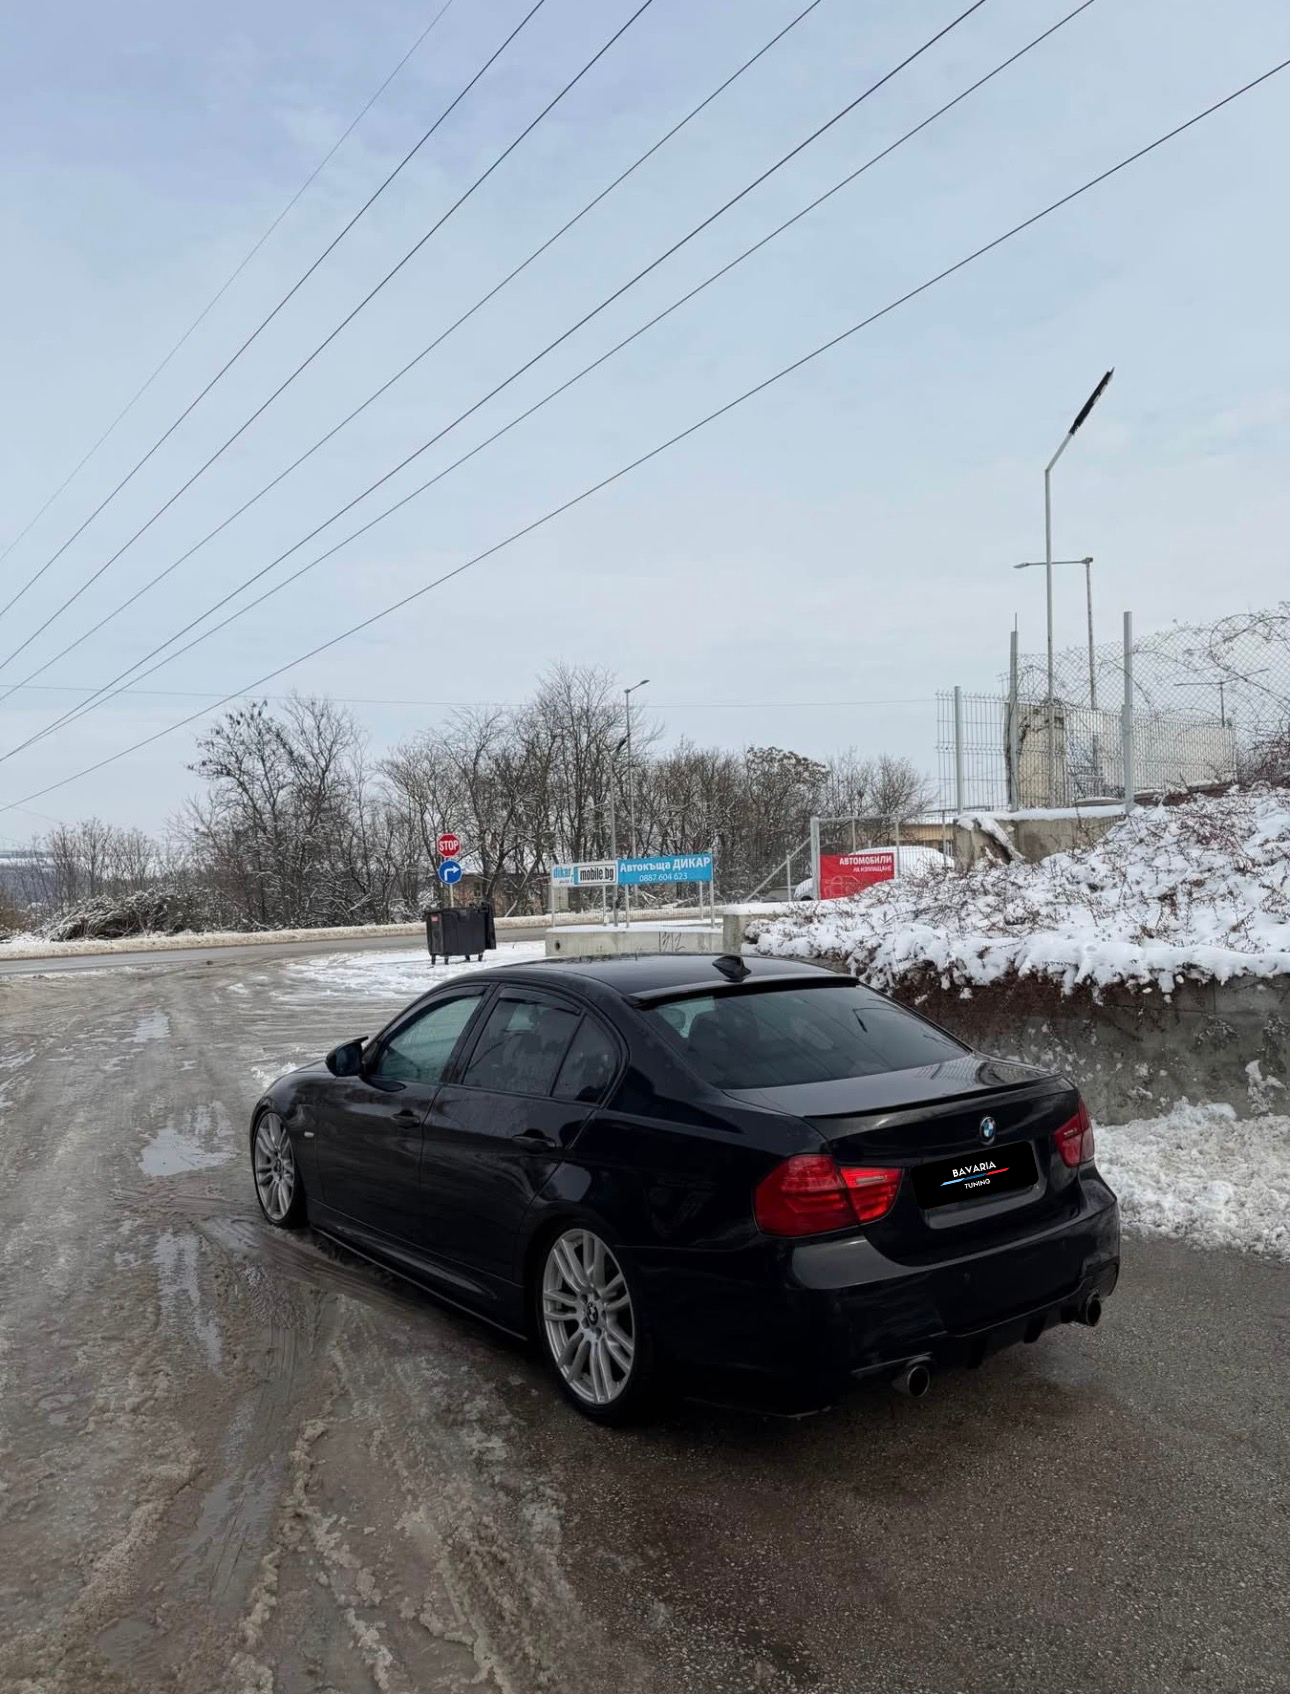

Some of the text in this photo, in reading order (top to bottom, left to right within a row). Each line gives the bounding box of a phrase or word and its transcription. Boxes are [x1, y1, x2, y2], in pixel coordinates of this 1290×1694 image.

[439, 840, 459, 851] STOP
[620, 857, 711, 873] Автокъща ДИКАР
[839, 855, 893, 866] АВТОМОБИЛИ
[580, 865, 614, 881] mobile.bg
[658, 873, 672, 881] 604
[674, 872, 688, 880] 623
